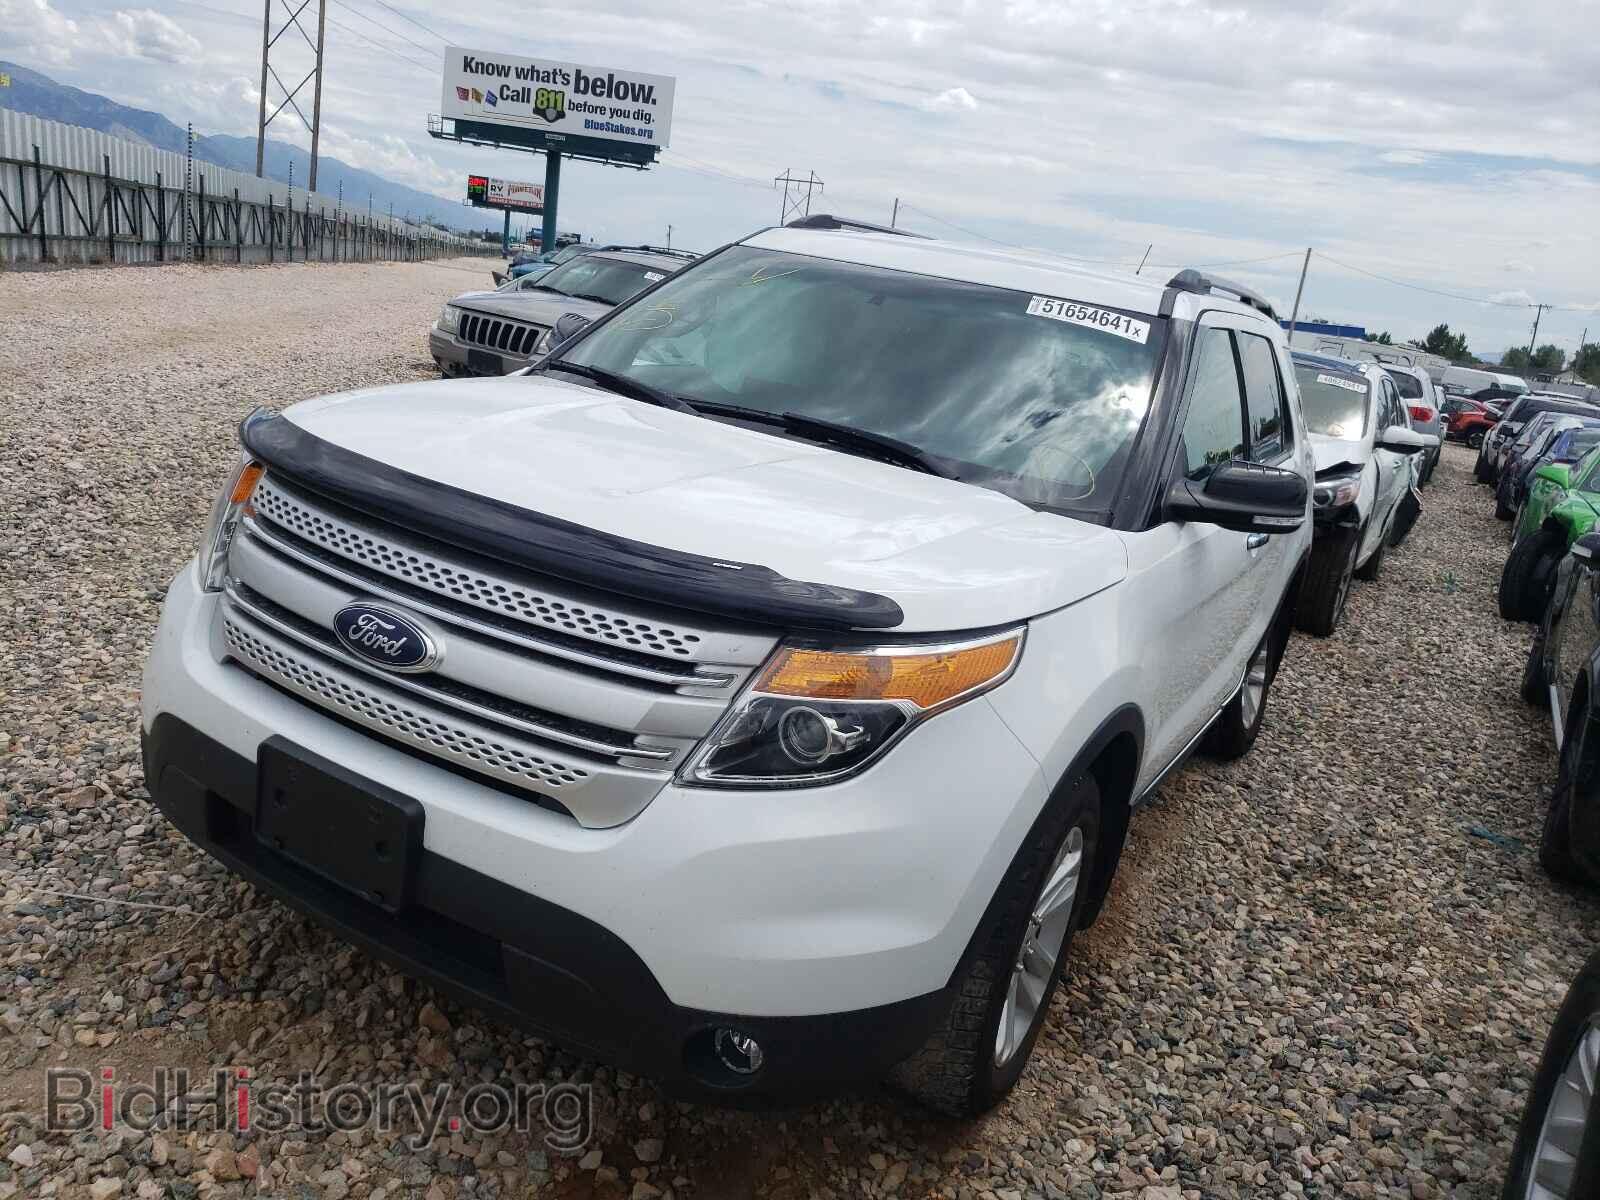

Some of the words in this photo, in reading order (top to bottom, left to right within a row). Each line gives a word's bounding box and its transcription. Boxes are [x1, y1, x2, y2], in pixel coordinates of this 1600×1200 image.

[463, 56, 511, 78] Know
[514, 65, 571, 86] what's
[573, 68, 657, 105] below.
[499, 84, 531, 104] Call
[535, 87, 565, 111] 811
[568, 99, 606, 116] before
[608, 107, 630, 119] you
[632, 109, 655, 125] dig.
[584, 118, 654, 139] BlueStakes.org
[348, 613, 408, 657] Ford
